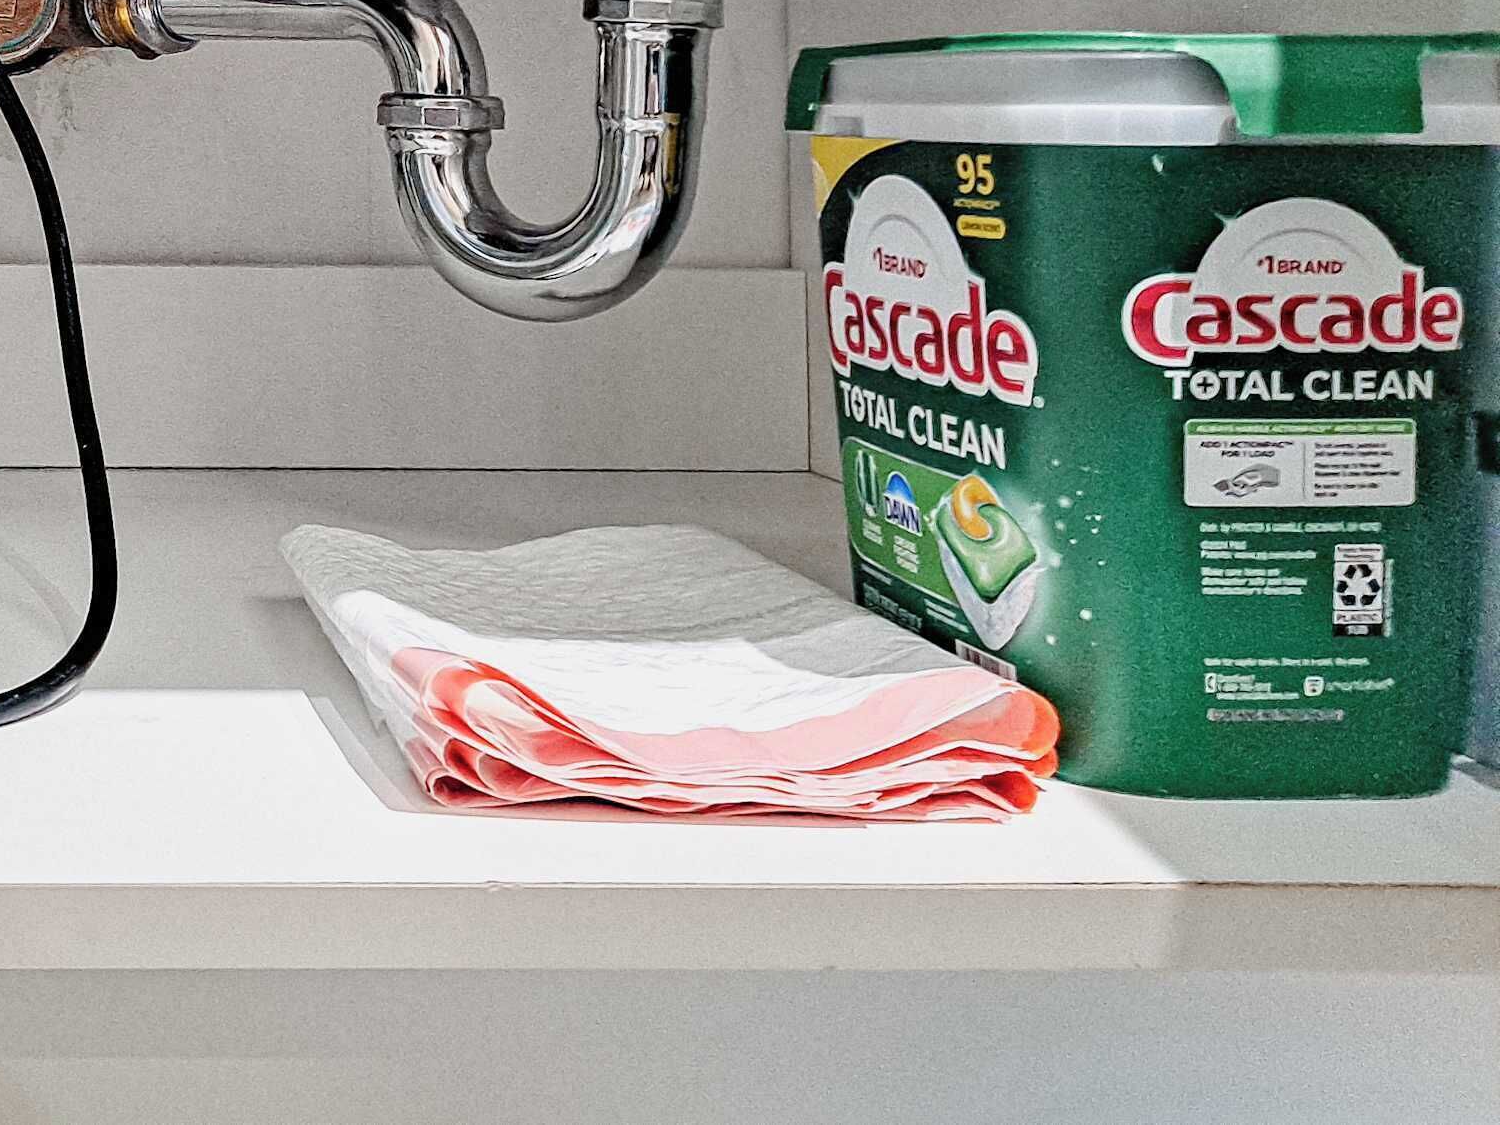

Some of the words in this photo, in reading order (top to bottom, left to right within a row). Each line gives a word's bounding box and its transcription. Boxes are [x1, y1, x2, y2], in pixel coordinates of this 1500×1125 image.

[955, 153, 996, 196] 95
[1277, 258, 1344, 275] BRAND
[824, 270, 1030, 394] Cascade
[1130, 272, 1459, 359] Cascade
[1164, 369, 1295, 401] TOTAL
[1302, 369, 1434, 401] CLEAN
[838, 379, 906, 439] TOTAL
[907, 404, 1007, 471] CLEAN
[883, 496, 921, 536] DAWN
